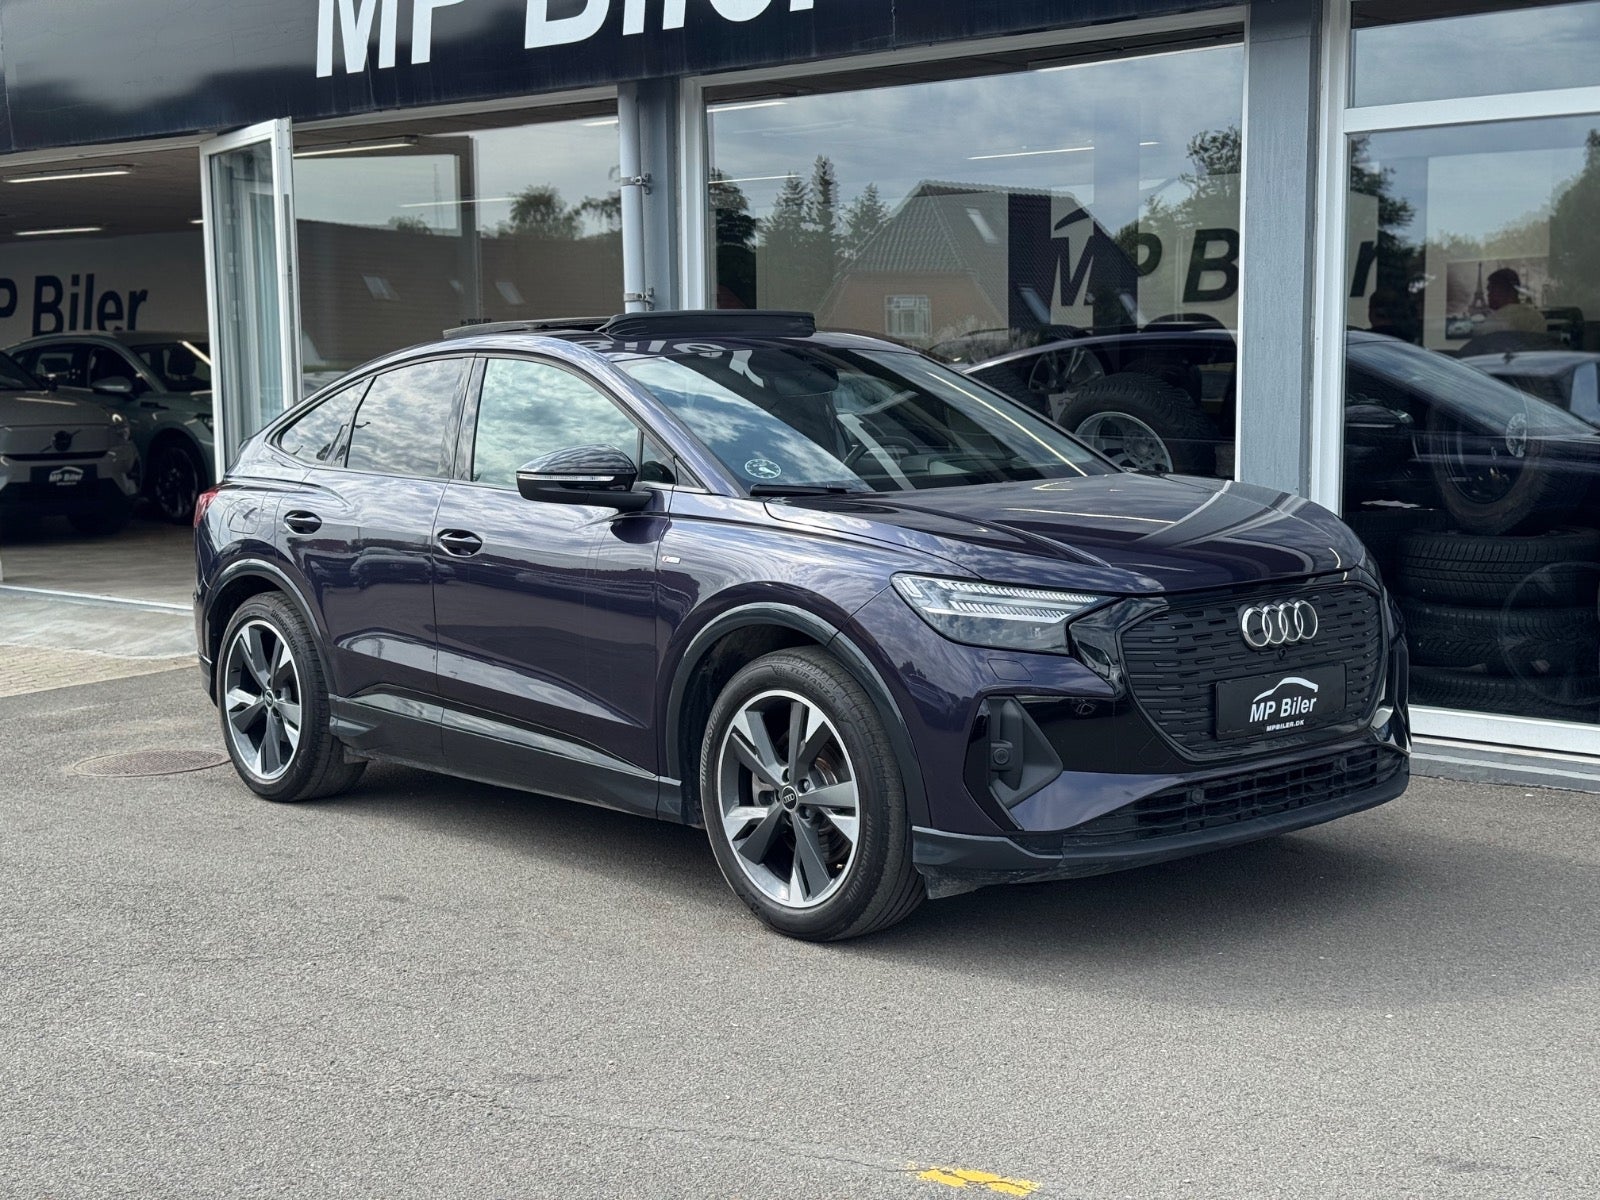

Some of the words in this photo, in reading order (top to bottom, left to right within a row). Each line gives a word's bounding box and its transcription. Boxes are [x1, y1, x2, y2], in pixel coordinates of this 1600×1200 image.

[31, 273, 148, 337] Biler
[789, 666, 839, 704] TURANZA
[1249, 702, 1276, 723] MP
[1280, 696, 1317, 717] Biler
[1266, 720, 1305, 732] MPBILER.DK
